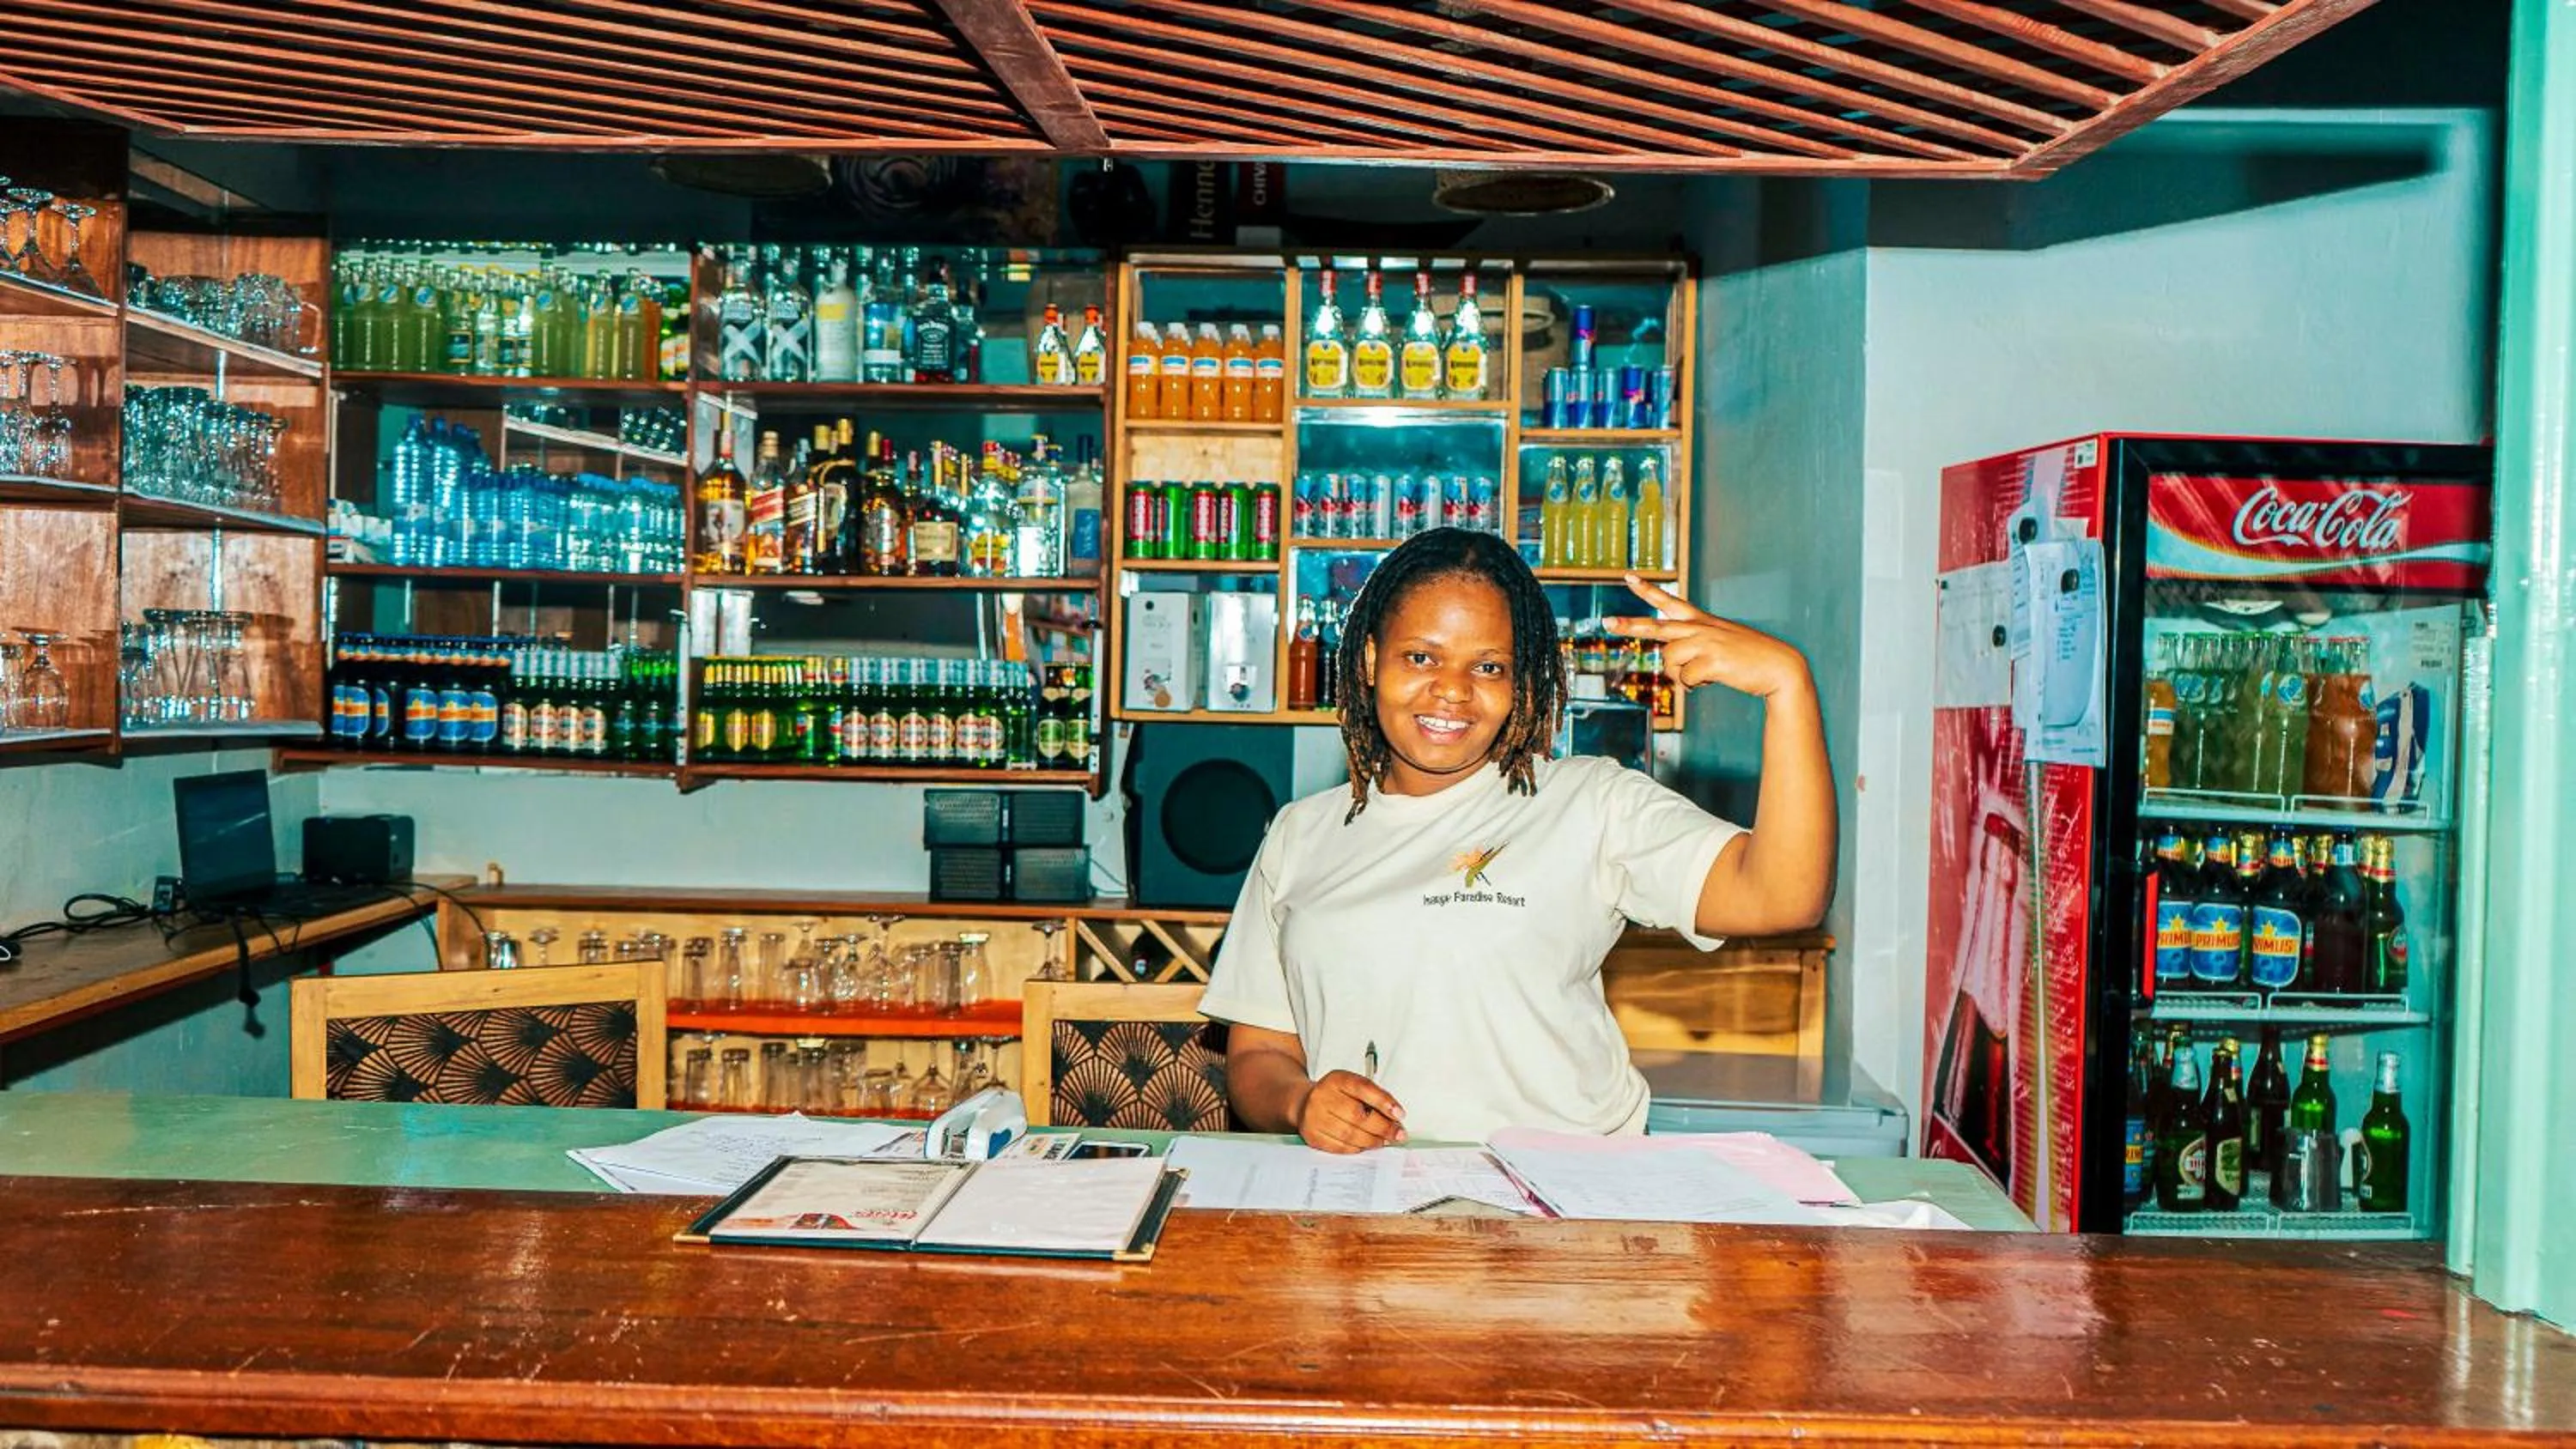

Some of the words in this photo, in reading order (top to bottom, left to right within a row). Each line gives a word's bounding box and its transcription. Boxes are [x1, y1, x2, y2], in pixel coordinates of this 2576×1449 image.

[2233, 487, 2414, 549] Coca-Cola
[1454, 891, 1493, 902] Paradise
[1497, 892, 1525, 906] Resort
